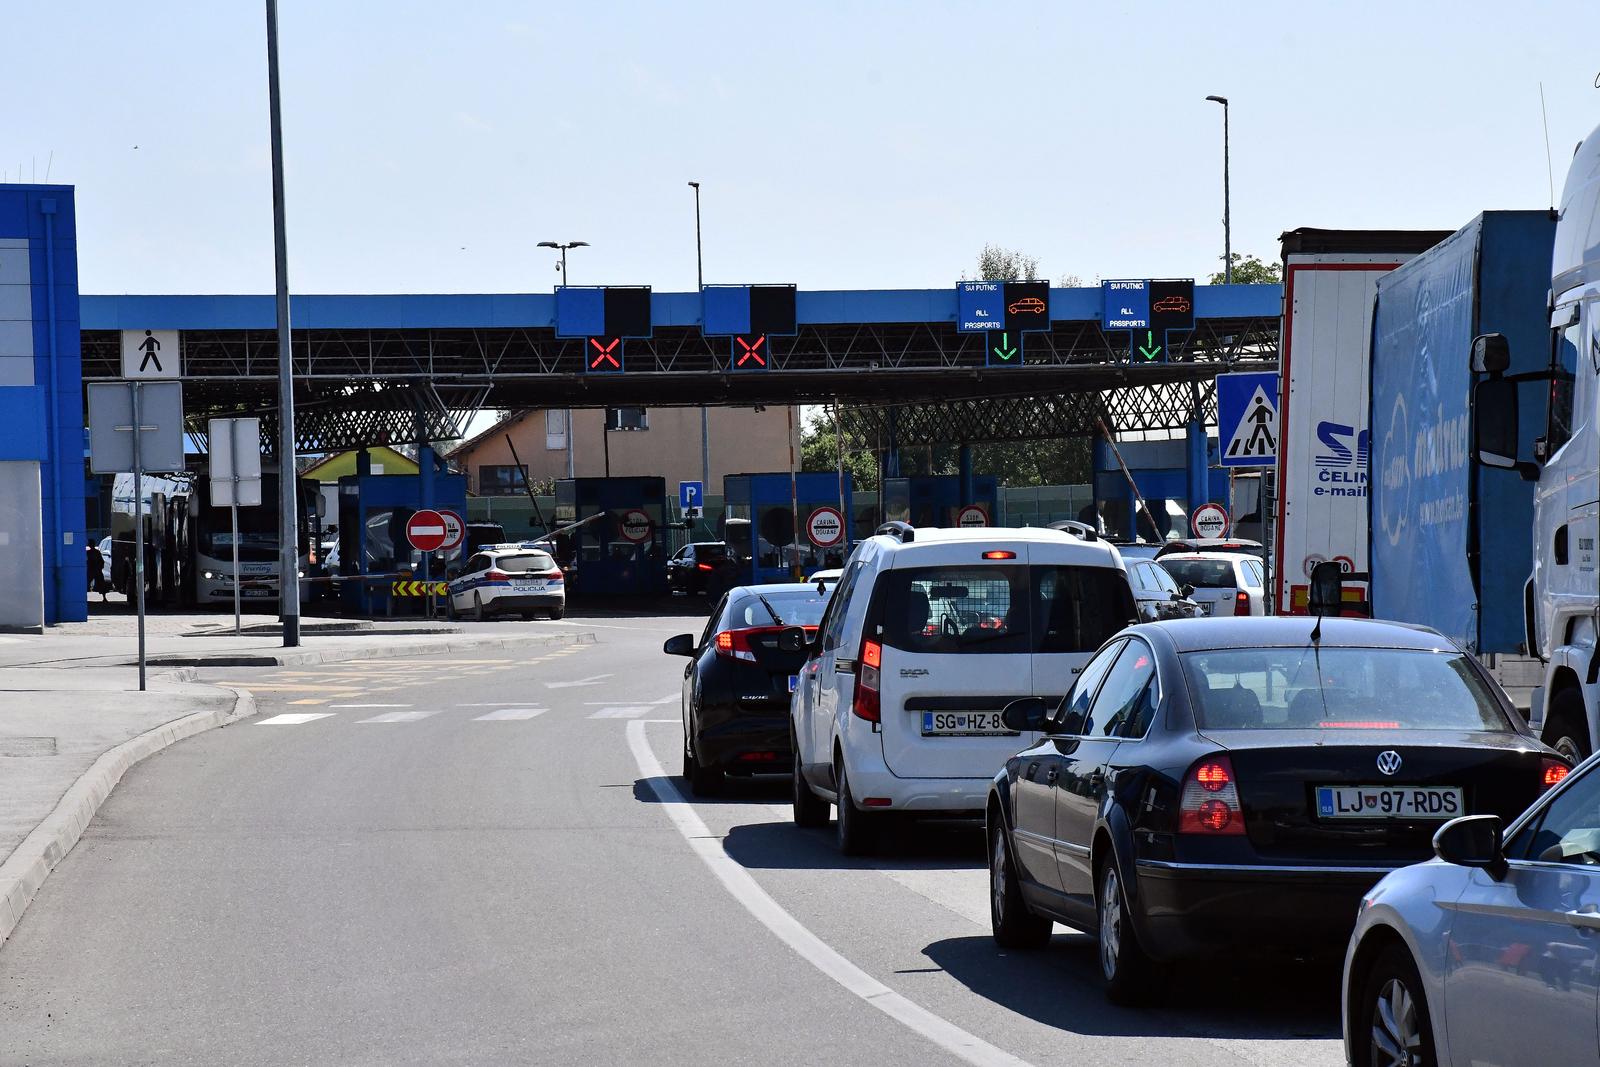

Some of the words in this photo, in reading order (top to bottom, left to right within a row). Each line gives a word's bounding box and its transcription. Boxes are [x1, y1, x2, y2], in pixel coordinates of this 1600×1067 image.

[686, 487, 696, 503] P
[1314, 486, 1367, 497] e-mail
[935, 714, 956, 730] SG
[1336, 791, 1363, 813] LJ
[1380, 791, 1458, 813] 97-RDS
